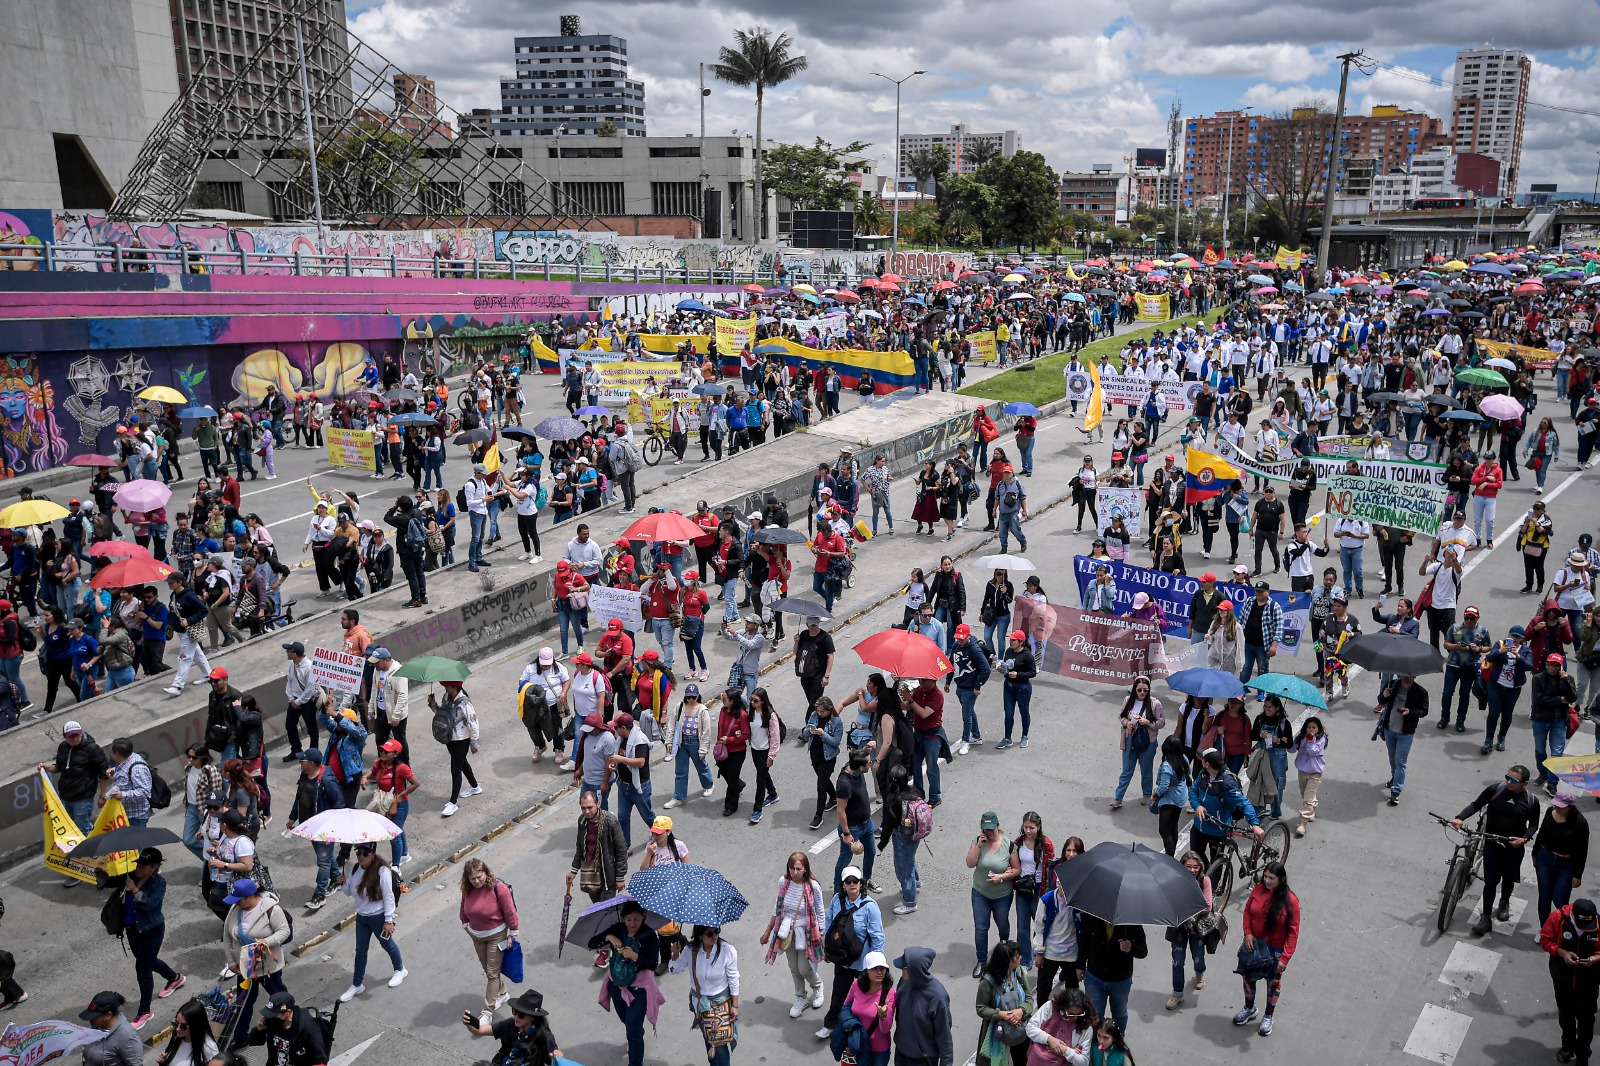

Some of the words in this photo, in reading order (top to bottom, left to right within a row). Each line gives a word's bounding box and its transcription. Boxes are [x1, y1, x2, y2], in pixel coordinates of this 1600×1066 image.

[500, 236, 582, 263] GORDO
[1110, 376, 1138, 384] SINDICAL
[1332, 445, 1350, 455] DE
[1390, 466, 1432, 485] TOLIMA
[1331, 476, 1366, 491] FABIO
[1121, 566, 1170, 589] FABIO
[1079, 614, 1112, 626] COLEGIO
[1112, 620, 1131, 629] ABEL
[1069, 634, 1146, 662] PRESENTE
[314, 647, 338, 662] ABAJO
[338, 653, 354, 666] LOS
[326, 672, 357, 684] EDUCACIÓN
[1081, 666, 1115, 677] DEFENSA
[1117, 671, 1126, 679] DE
